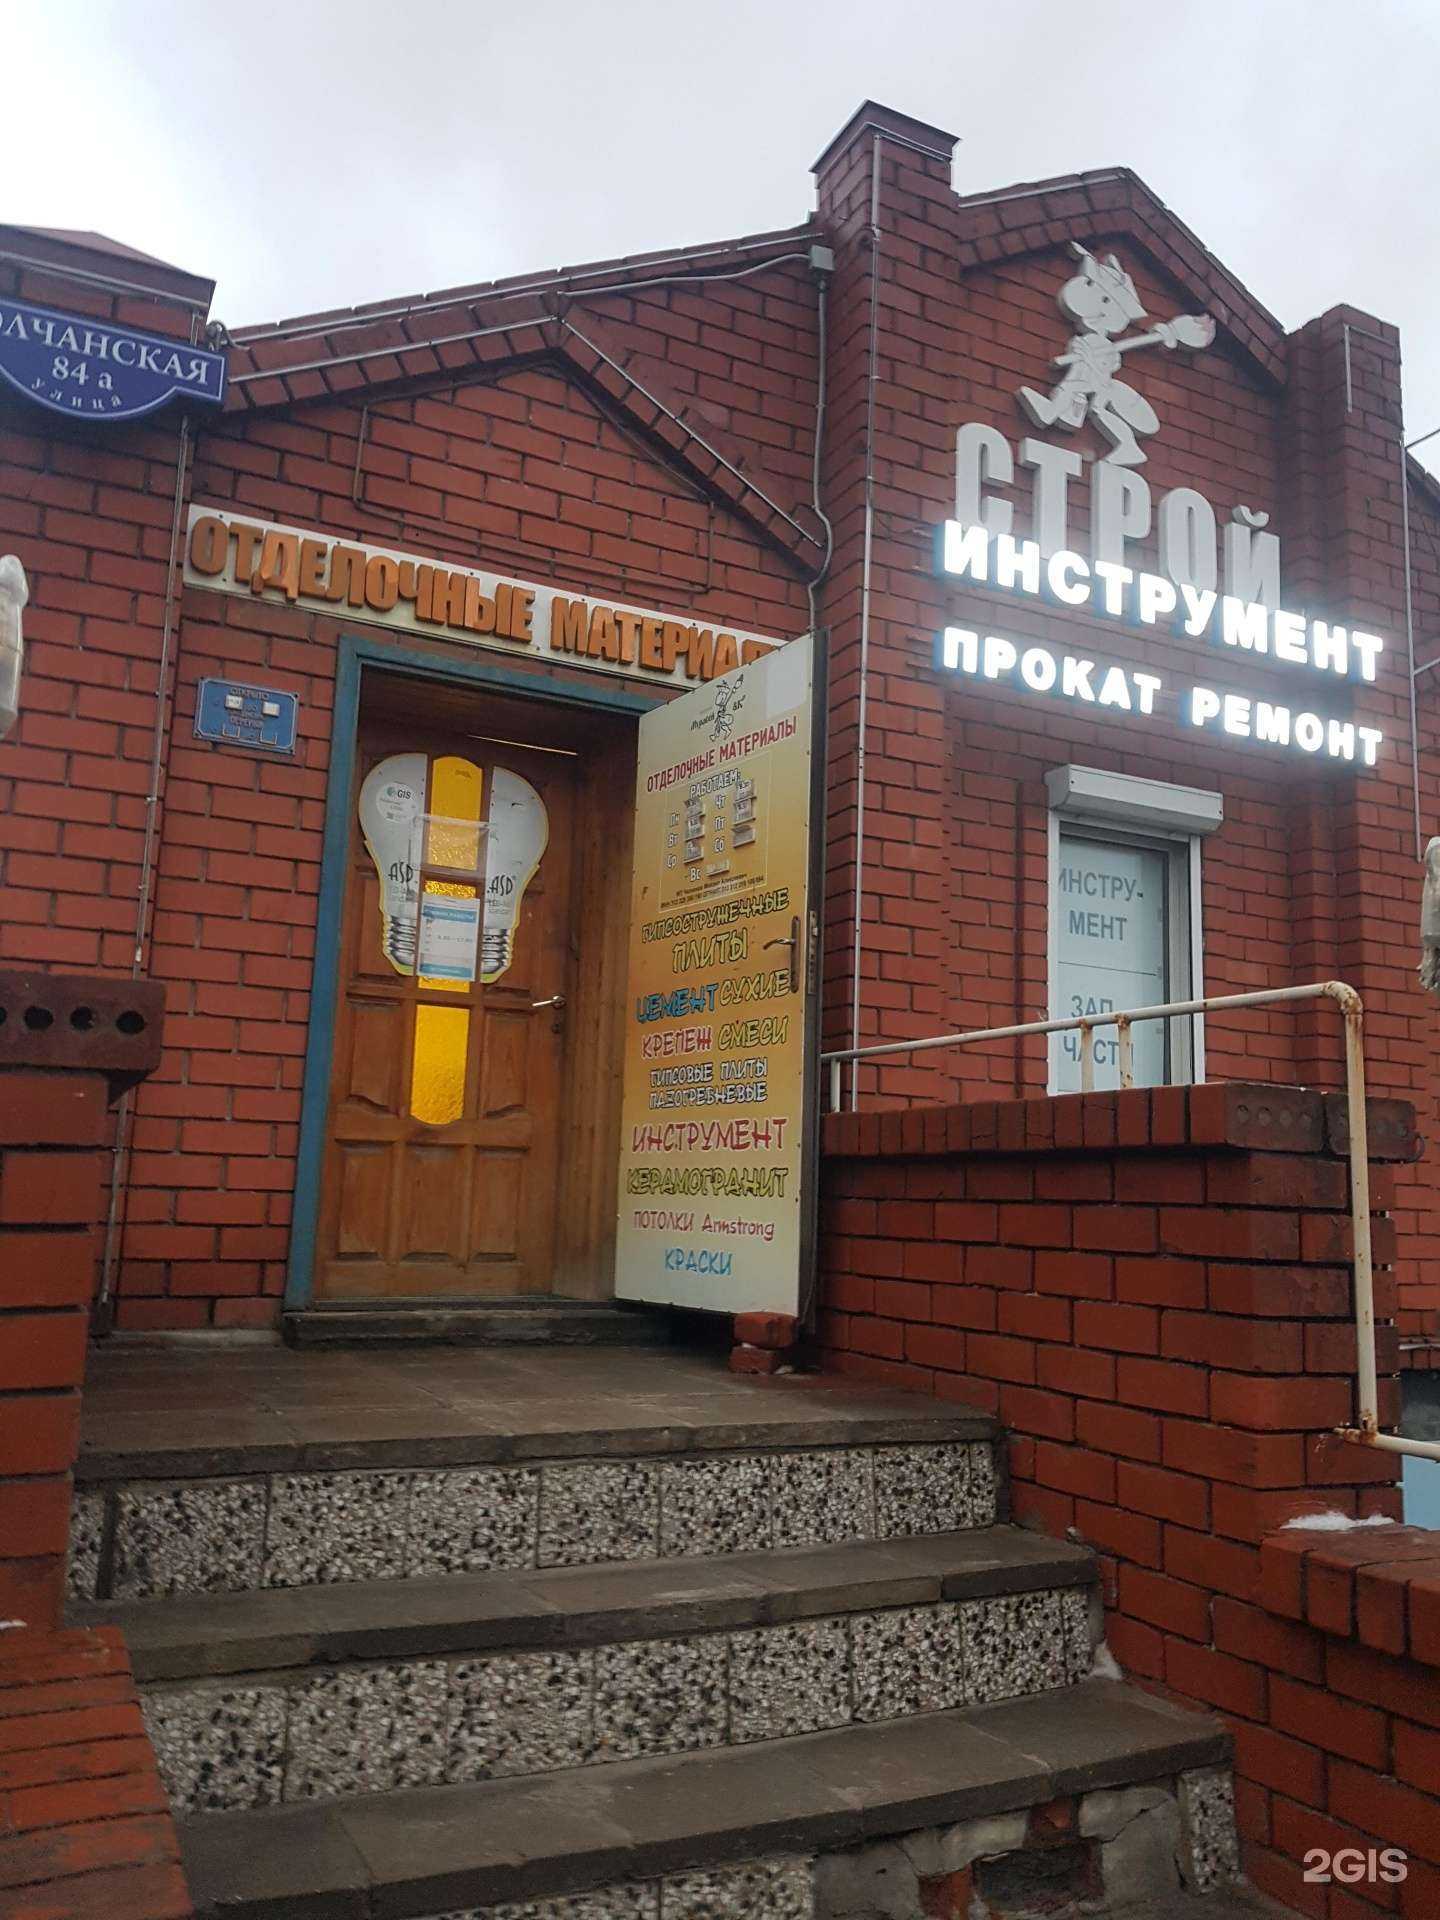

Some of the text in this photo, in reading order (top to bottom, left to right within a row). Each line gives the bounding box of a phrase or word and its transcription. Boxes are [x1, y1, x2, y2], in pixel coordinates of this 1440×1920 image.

[0, 311, 209, 385] ЛЧАНСКАЯ
[52, 355, 88, 385] 84
[31, 377, 122, 411] улица
[955, 422, 1281, 609] СТРОЙ
[190, 516, 536, 643] ОТДЕЛОЧНЫЕ
[938, 519, 1384, 682] ИНСТРУМЕНТ
[938, 626, 1383, 767] ПРОКАТ РЕМОНТ
[647, 749, 715, 792] ОТДЕЛОЧНЫЕ
[719, 716, 797, 763] МАТЕРИАЛЫ
[388, 861, 414, 884] ASD
[1059, 867, 1144, 902] ИНСТРУ-
[641, 888, 790, 943] ГИПСОСТРУЖЕЧНЫЕ
[1069, 910, 1127, 941] МЕНТ
[672, 928, 748, 973] ПЛИТЫ
[637, 983, 719, 1023] ЦЕМЕНТ
[719, 969, 791, 1006] СУХИЕ
[642, 1026, 712, 1059] КРЕПЕЖ
[718, 1015, 789, 1050] СМЕСИ
[1064, 1036, 1134, 1065] ЧСТ
[651, 1057, 768, 1087] ГИПСОВЫЕ ПЛИТЫ
[650, 1082, 768, 1110] ПАЗОГРЕБНЕВЫЕ
[632, 1118, 787, 1152] ИНСТРУМЕНТ
[627, 1167, 788, 1197] КЕРАМОГРАНИТ
[634, 1210, 775, 1241] ПОТОЛКИ Armstrong
[665, 1248, 732, 1275] КРАСКИ
